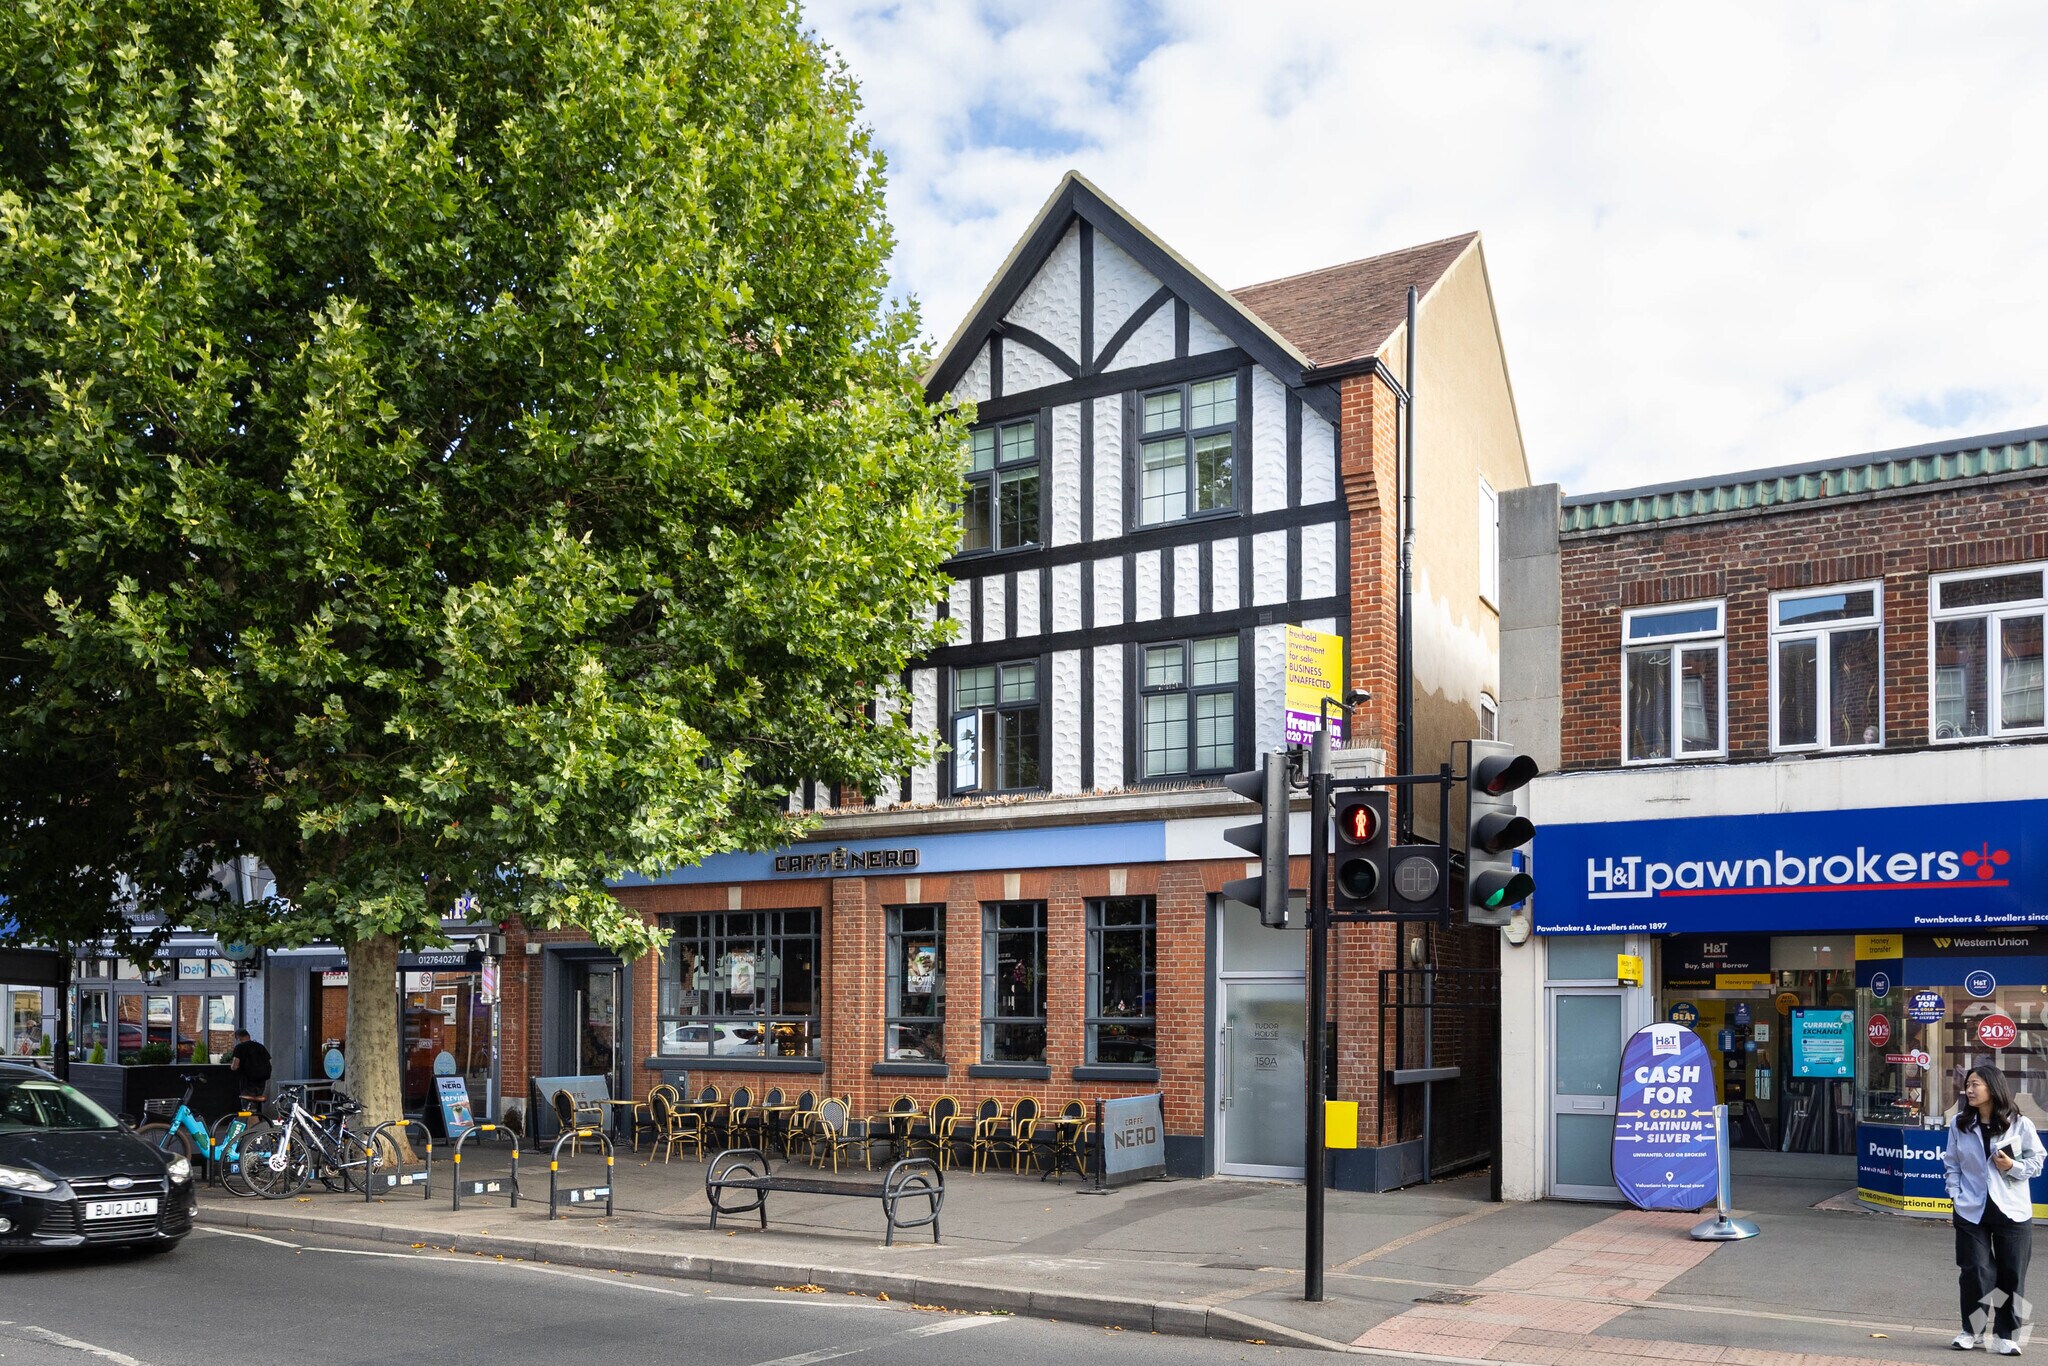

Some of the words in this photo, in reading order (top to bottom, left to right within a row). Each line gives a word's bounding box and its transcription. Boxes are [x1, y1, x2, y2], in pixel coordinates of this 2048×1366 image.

[1289, 628, 1317, 643] freehold
[1289, 642, 1325, 655] investment
[1289, 651, 1299, 661] for
[1300, 653, 1314, 664] sale
[1289, 663, 1322, 677] BUSINESS
[1289, 674, 1331, 689] UNAFFECTED
[1286, 731, 1302, 743] 020
[851, 848, 920, 870] NERO
[1587, 856, 1642, 892] H&T
[1646, 847, 1959, 897] pawnbrokers
[1914, 915, 1973, 924] Pawnbrokers
[1983, 913, 2026, 923] Jewellers
[1536, 923, 1584, 932] Pawnbrokers
[1592, 923, 1627, 932] Jewellers
[1628, 923, 1648, 931] since
[1649, 922, 1667, 930] 1897
[1870, 938, 1889, 946] Money
[1954, 938, 1997, 947] Western
[1998, 937, 2029, 947] Union
[158, 948, 170, 957] BAR
[1703, 942, 1728, 954] H&T
[1869, 946, 1892, 954] transfer
[418, 955, 464, 964] 01276402741
[1672, 1012, 1696, 1021] BEAT
[1254, 1022, 1279, 1030] TUDOR
[1869, 1024, 1889, 1036] 20%
[1981, 1025, 2014, 1038] 20%
[1655, 1036, 1676, 1045] H&T
[1254, 1056, 1278, 1066] 150A
[1634, 1065, 1700, 1084] CASH
[1643, 1086, 1693, 1104] FOR
[1649, 1109, 1687, 1119] GOLD
[1634, 1121, 1703, 1131] PLATINUM
[1114, 1126, 1156, 1149] NERO
[1646, 1133, 1691, 1143] SILVER
[1893, 1169, 1903, 1177] Use
[96, 1203, 122, 1216] BJ12
[127, 1202, 148, 1214] LOA
